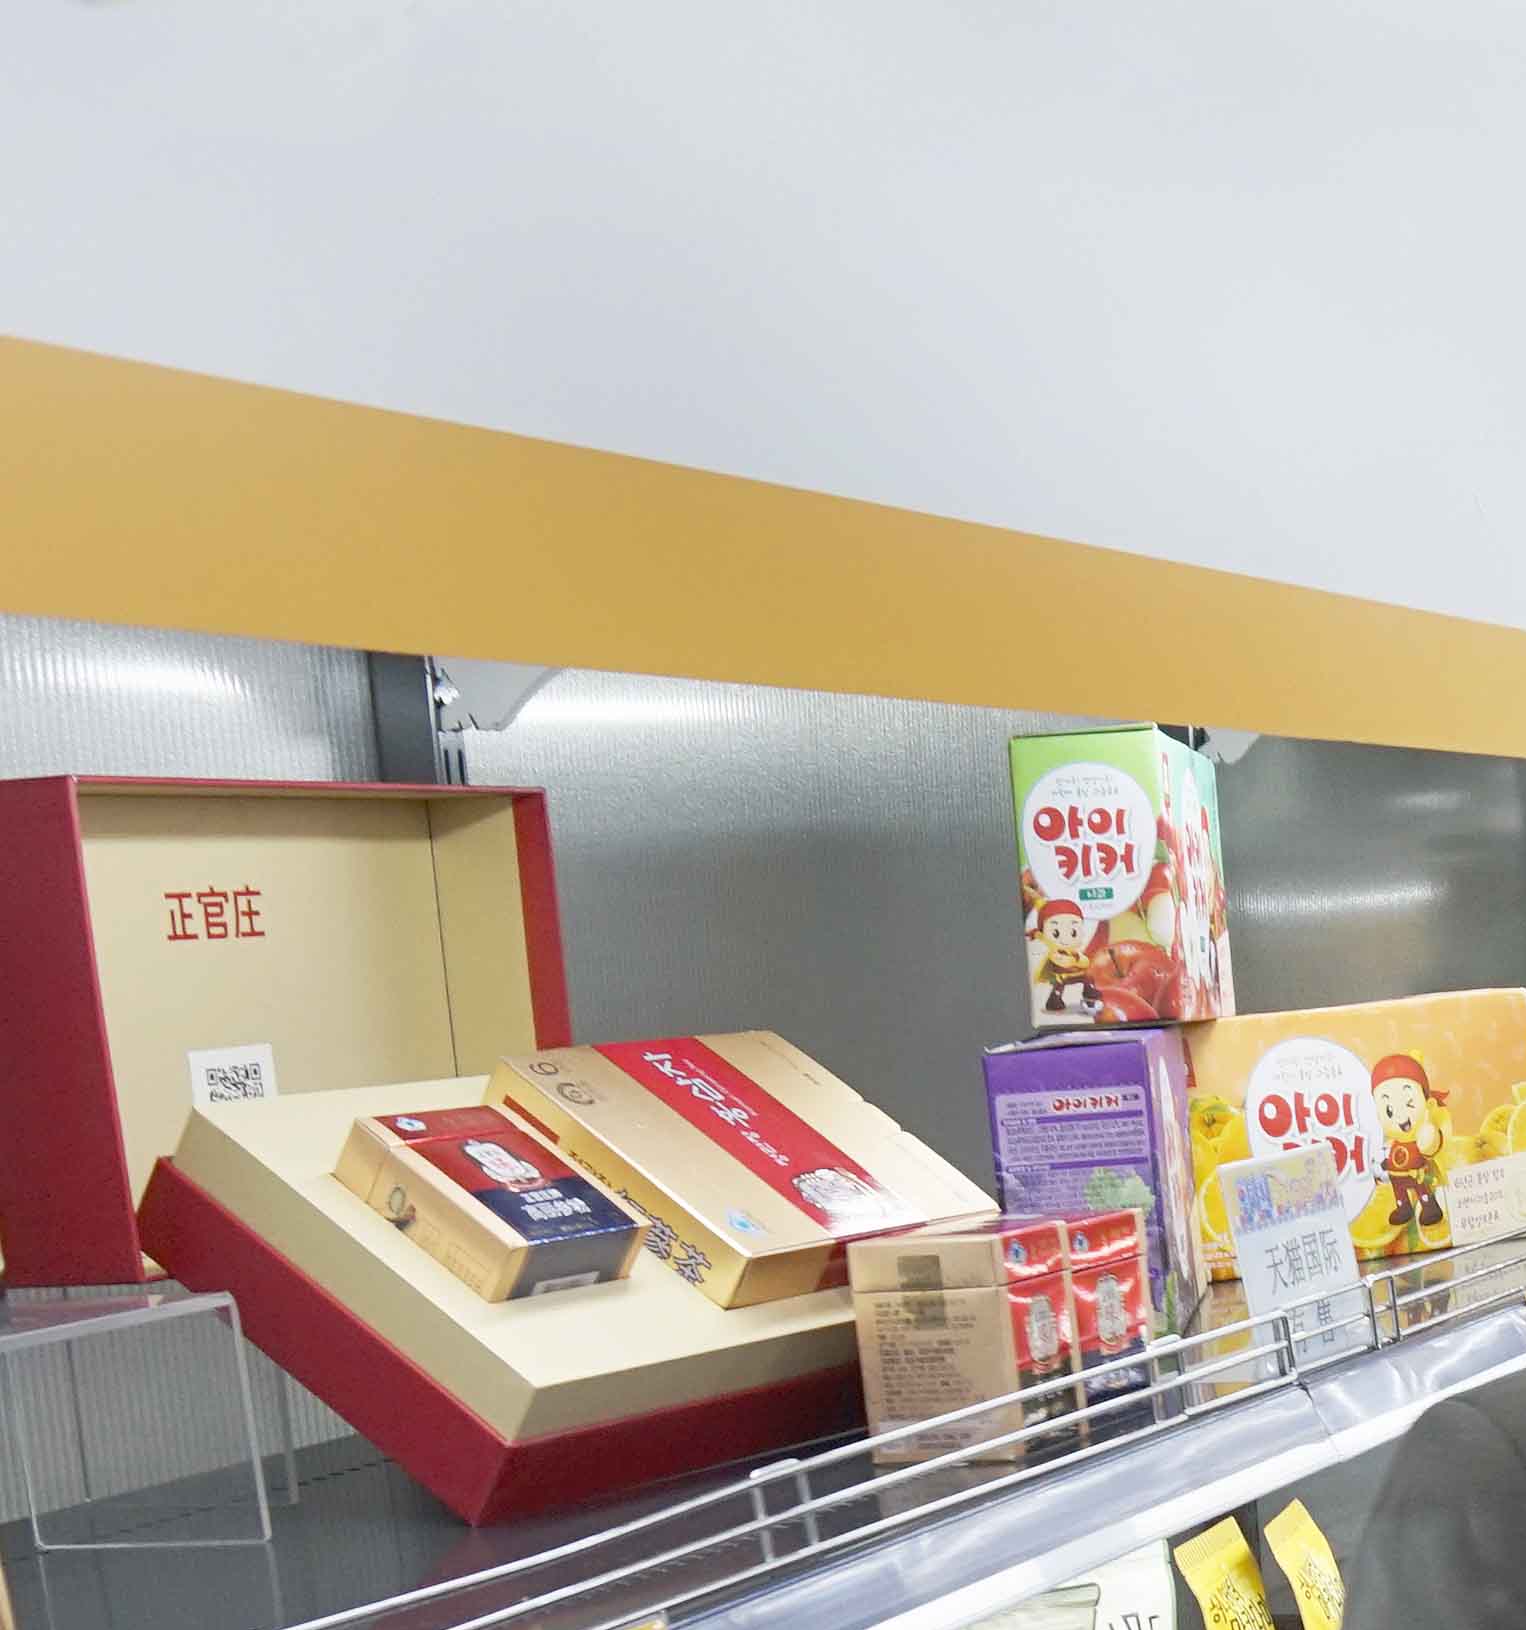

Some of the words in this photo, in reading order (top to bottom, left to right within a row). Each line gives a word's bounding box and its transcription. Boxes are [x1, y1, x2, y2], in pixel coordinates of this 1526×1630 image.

[1032, 804, 1127, 842] 아이
[1054, 842, 1135, 881] 키커
[163, 886, 266, 942] 正官庄
[1258, 1091, 1355, 1138] 아이
